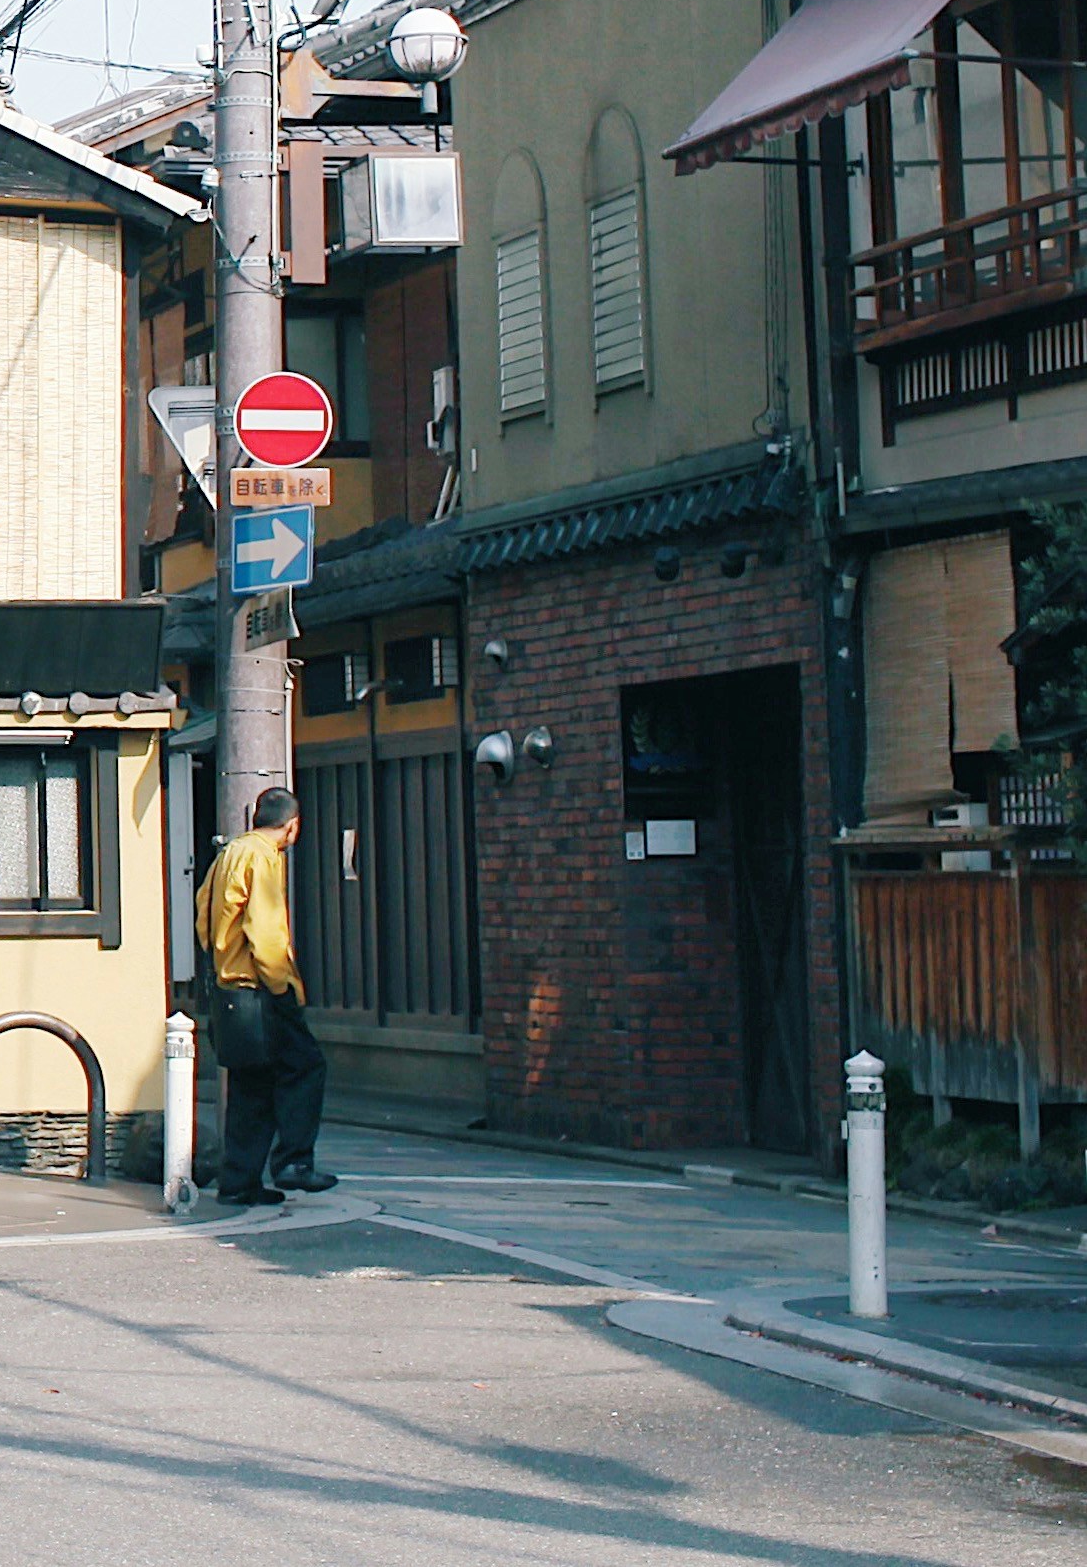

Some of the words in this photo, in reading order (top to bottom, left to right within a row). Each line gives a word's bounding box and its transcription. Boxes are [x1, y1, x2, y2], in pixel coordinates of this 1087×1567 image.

[236, 478, 325, 497] 自転車を除く
